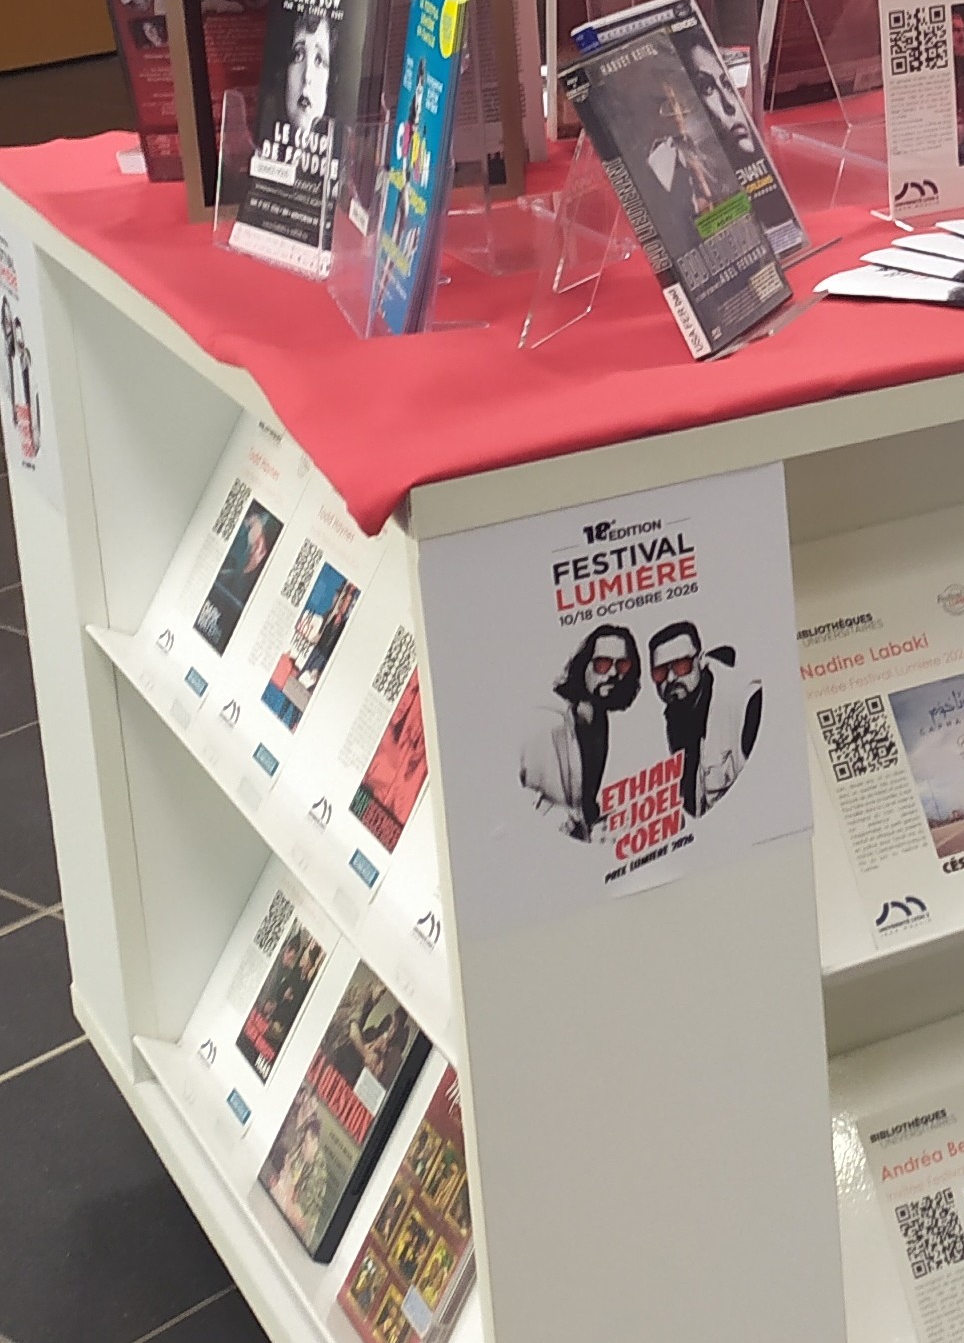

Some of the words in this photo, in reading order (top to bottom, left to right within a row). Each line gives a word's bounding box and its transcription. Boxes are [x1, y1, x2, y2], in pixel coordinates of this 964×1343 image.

[275, 122, 291, 145] LE
[609, 519, 662, 542] EDITION
[553, 533, 695, 585] FESTIVAL
[555, 555, 697, 612] LUMIÈRE
[559, 608, 594, 627] 10/18
[597, 592, 663, 617] OCTOBRE
[666, 582, 699, 600] 2026
[800, 654, 866, 682] Nadine
[869, 633, 930, 663] Labaki
[602, 751, 685, 813] ETHAN
[609, 811, 628, 831] ET
[631, 784, 683, 829] JOEL
[615, 811, 681, 860] COEN
[881, 1146, 944, 1182] Andréa
